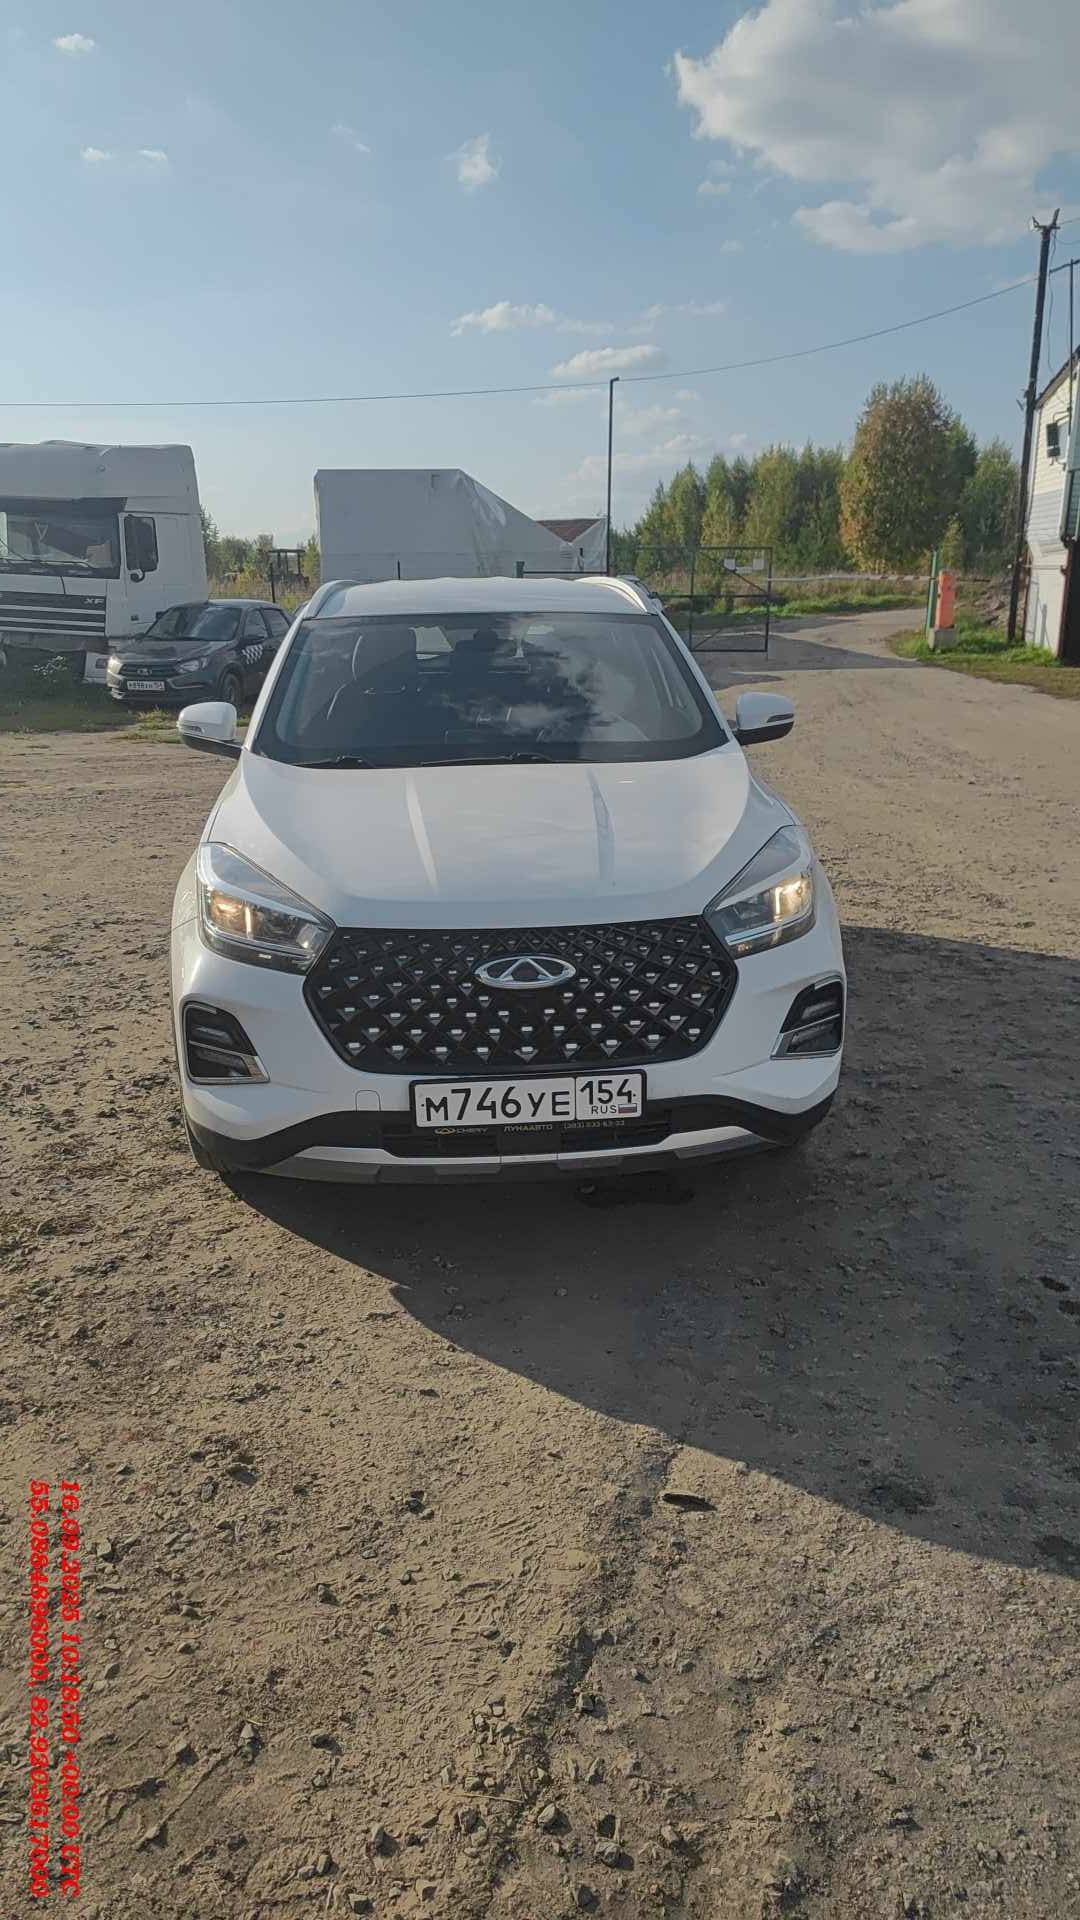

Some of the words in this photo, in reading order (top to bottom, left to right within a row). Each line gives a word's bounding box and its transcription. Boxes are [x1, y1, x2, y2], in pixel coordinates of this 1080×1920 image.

[425, 1086, 570, 1122] М746УЕ
[580, 1078, 633, 1105] 154
[591, 1104, 617, 1115] RUS
[456, 1127, 489, 1135] CHERY
